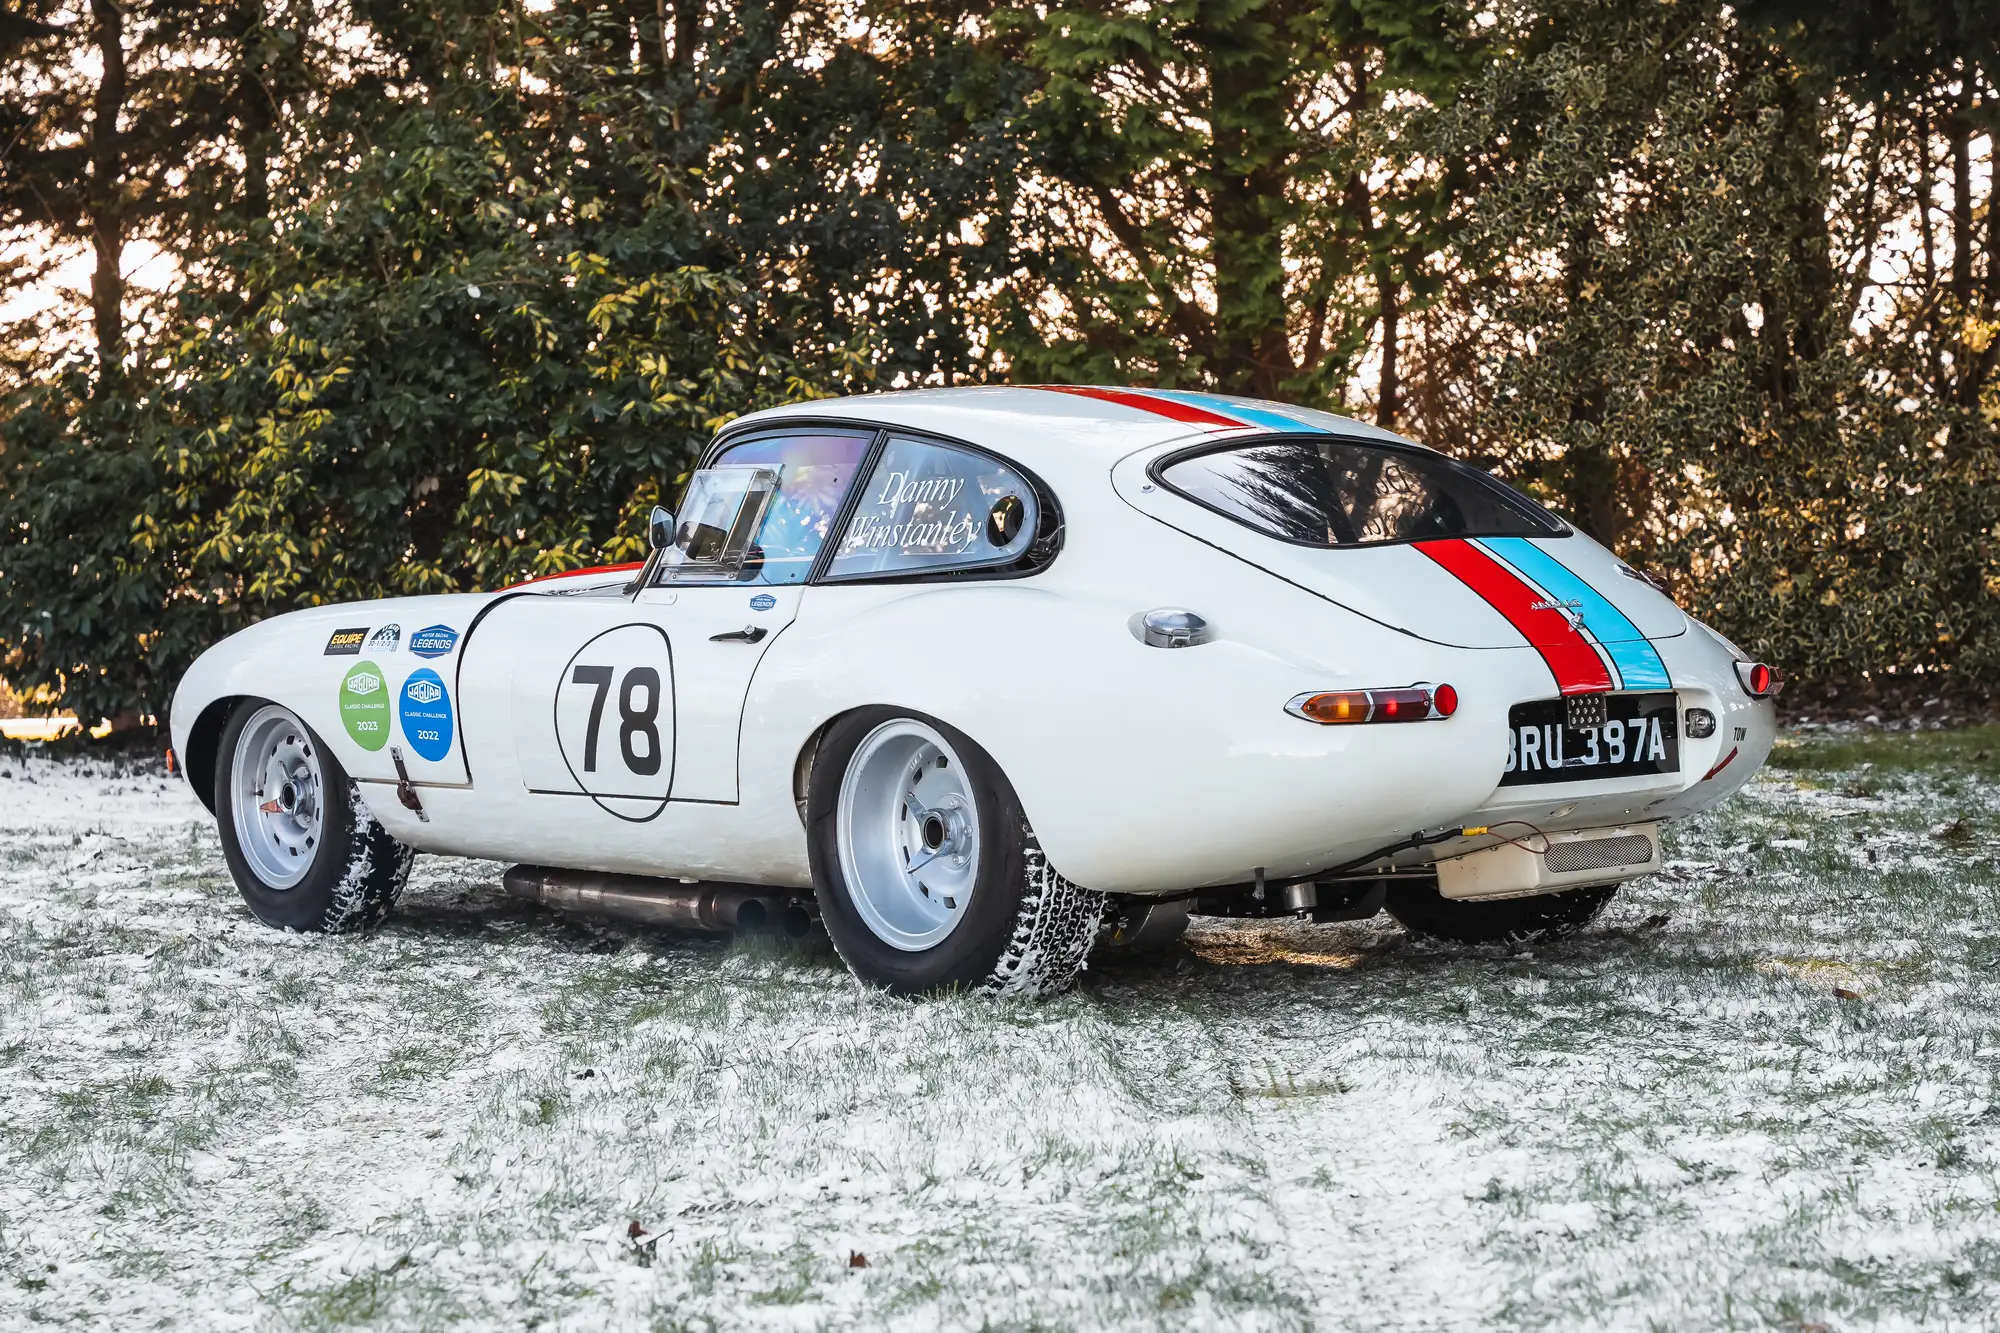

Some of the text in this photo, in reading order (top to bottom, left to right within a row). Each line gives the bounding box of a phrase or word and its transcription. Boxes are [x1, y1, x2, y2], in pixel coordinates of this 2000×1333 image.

[877, 470, 965, 510] Danny
[846, 510, 982, 553] Winstanley
[331, 633, 364, 644] EQUIPE
[412, 638, 452, 649] LEGENDS
[348, 675, 378, 692] JAGUAR
[409, 683, 440, 700] JAGUAR
[357, 721, 379, 731] 2023
[572, 665, 661, 776] 78
[417, 729, 440, 741] 2022
[1579, 717, 1666, 765] 387A
[1733, 726, 1747, 741] TOW
